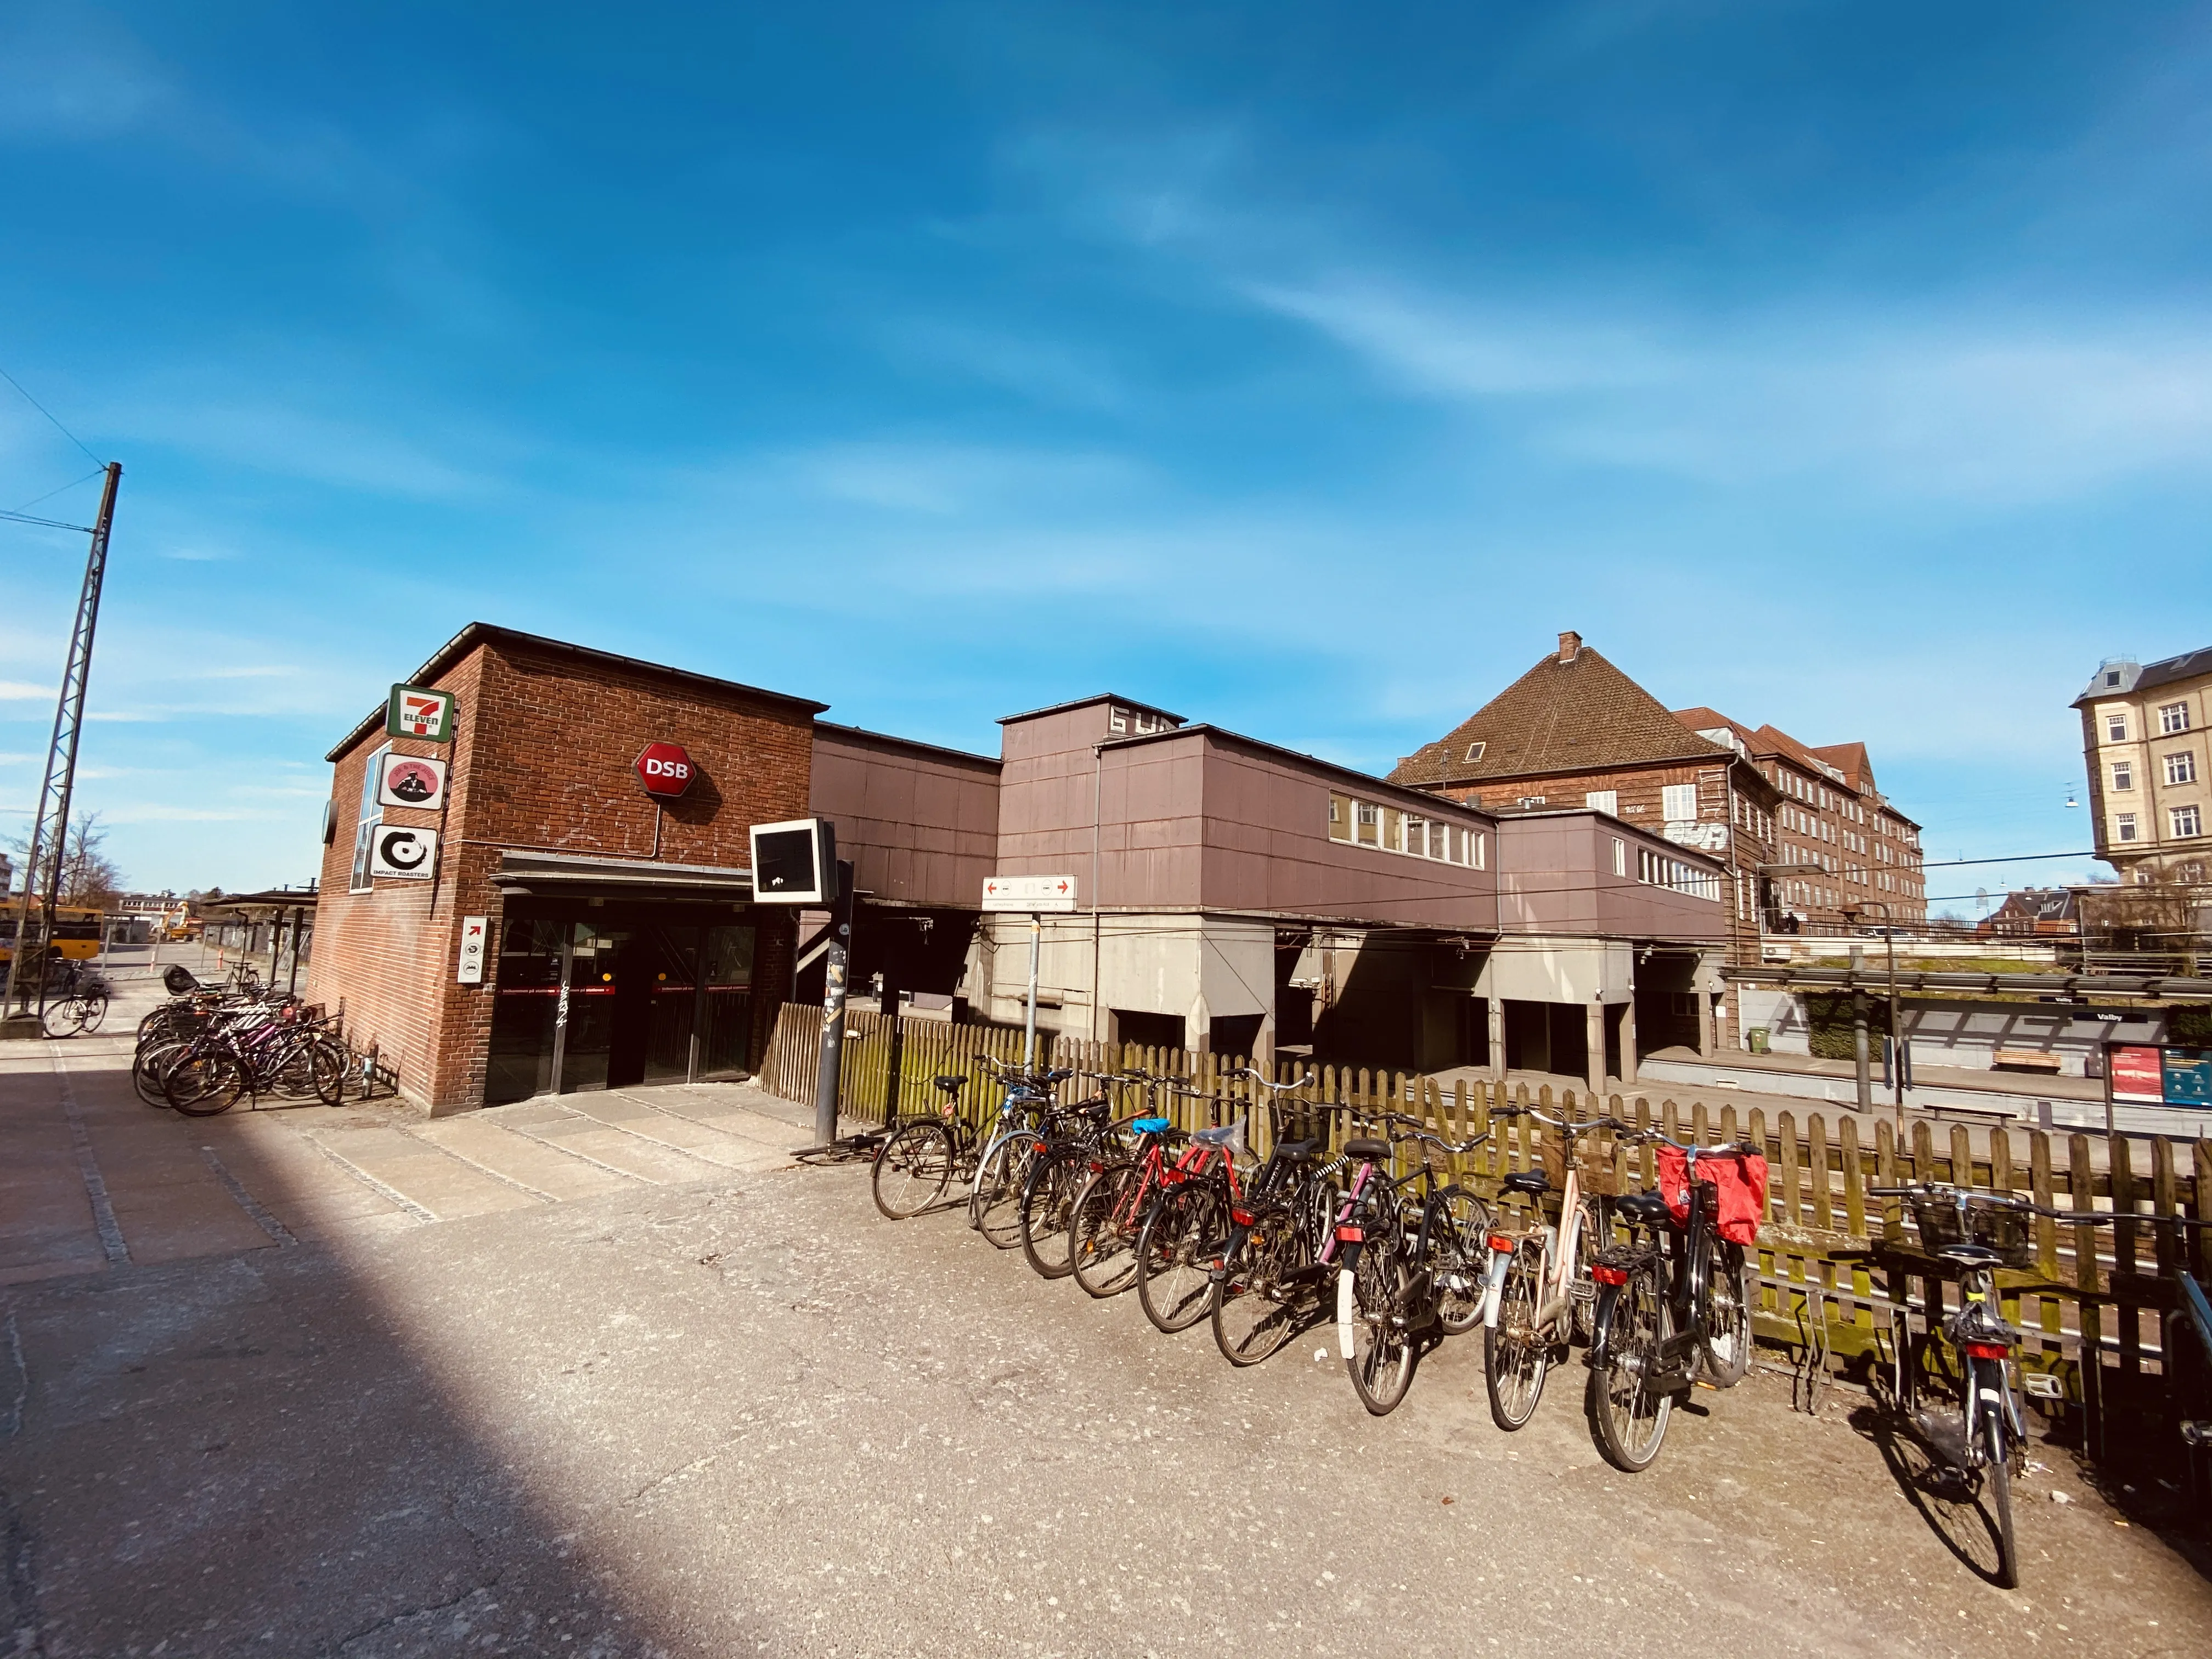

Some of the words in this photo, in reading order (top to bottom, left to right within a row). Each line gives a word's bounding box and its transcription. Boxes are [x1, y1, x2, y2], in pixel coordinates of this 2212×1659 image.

[407, 696, 439, 735] 7
[646, 758, 688, 779] DSB
[2097, 1013, 2123, 1022] Valby
